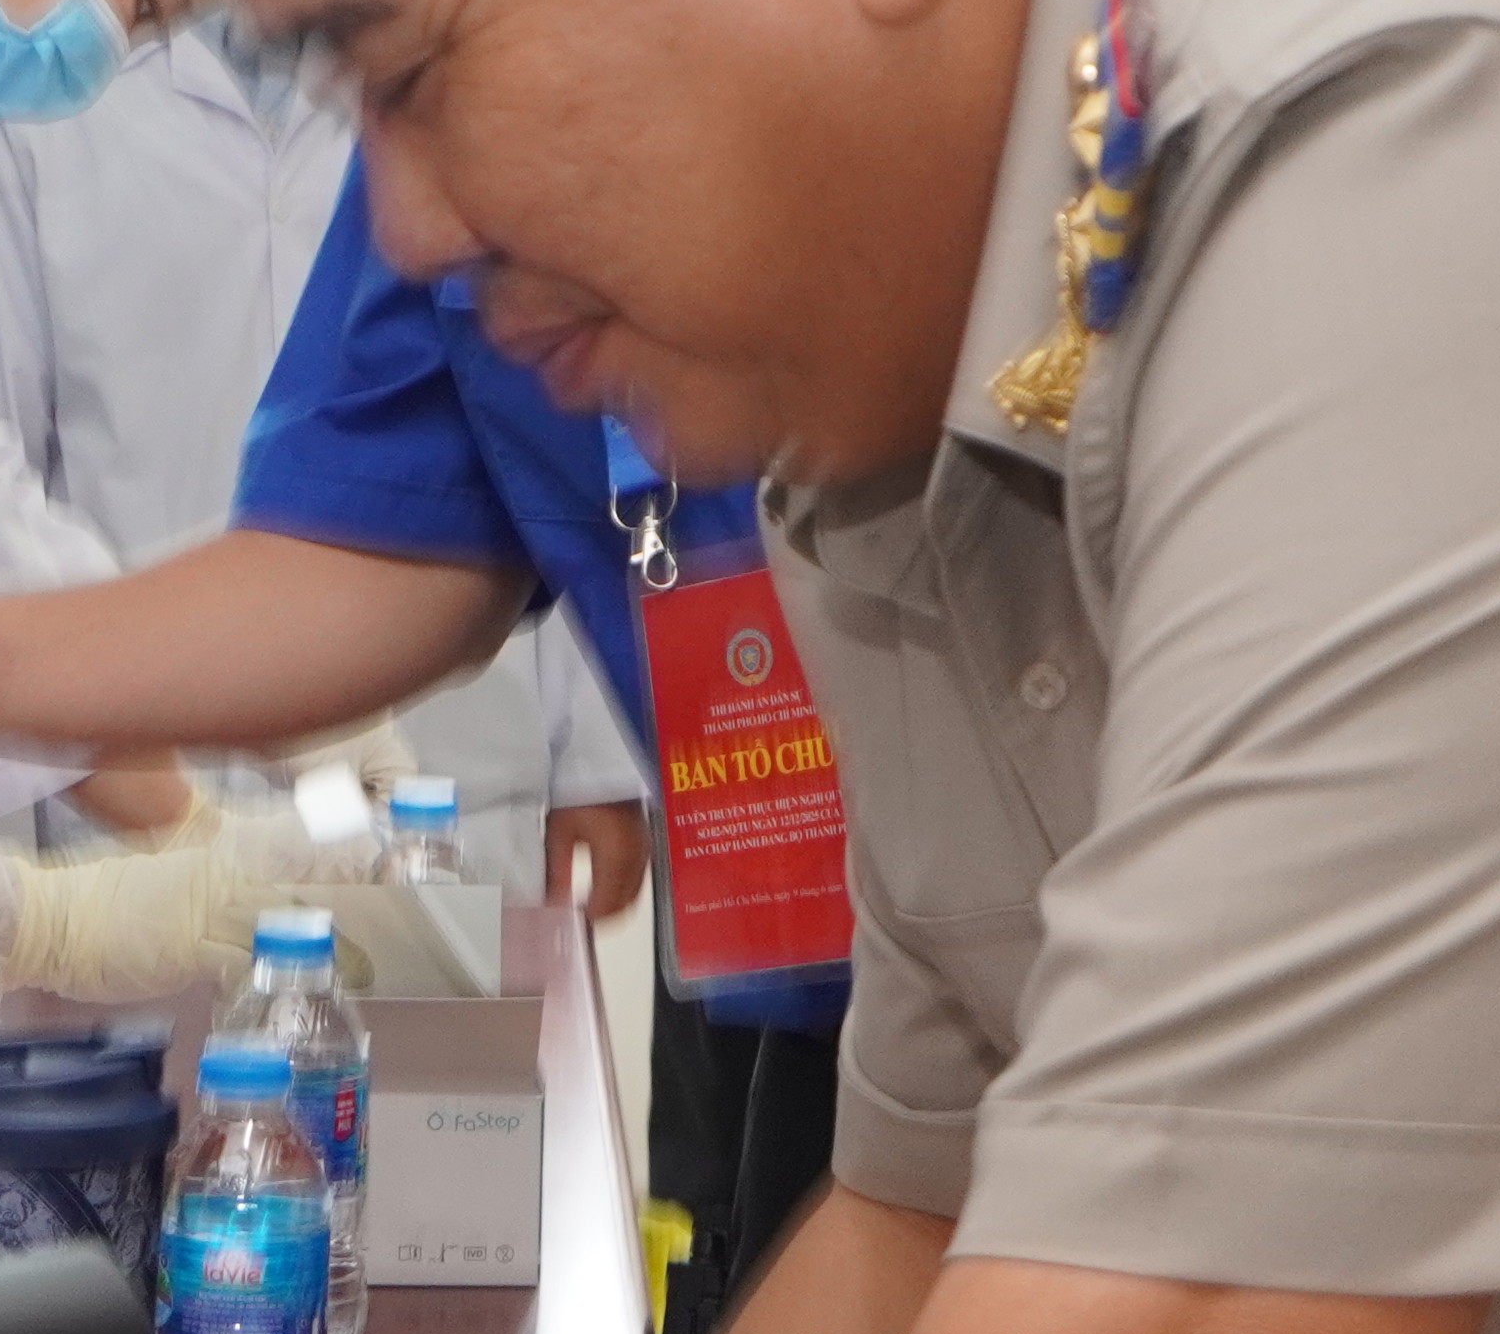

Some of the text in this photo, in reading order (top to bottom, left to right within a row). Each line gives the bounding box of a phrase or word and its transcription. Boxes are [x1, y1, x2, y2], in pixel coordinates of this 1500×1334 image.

[670, 733, 834, 792] BAN TỔ CHỨ
[467, 1249, 483, 1259] IVD
